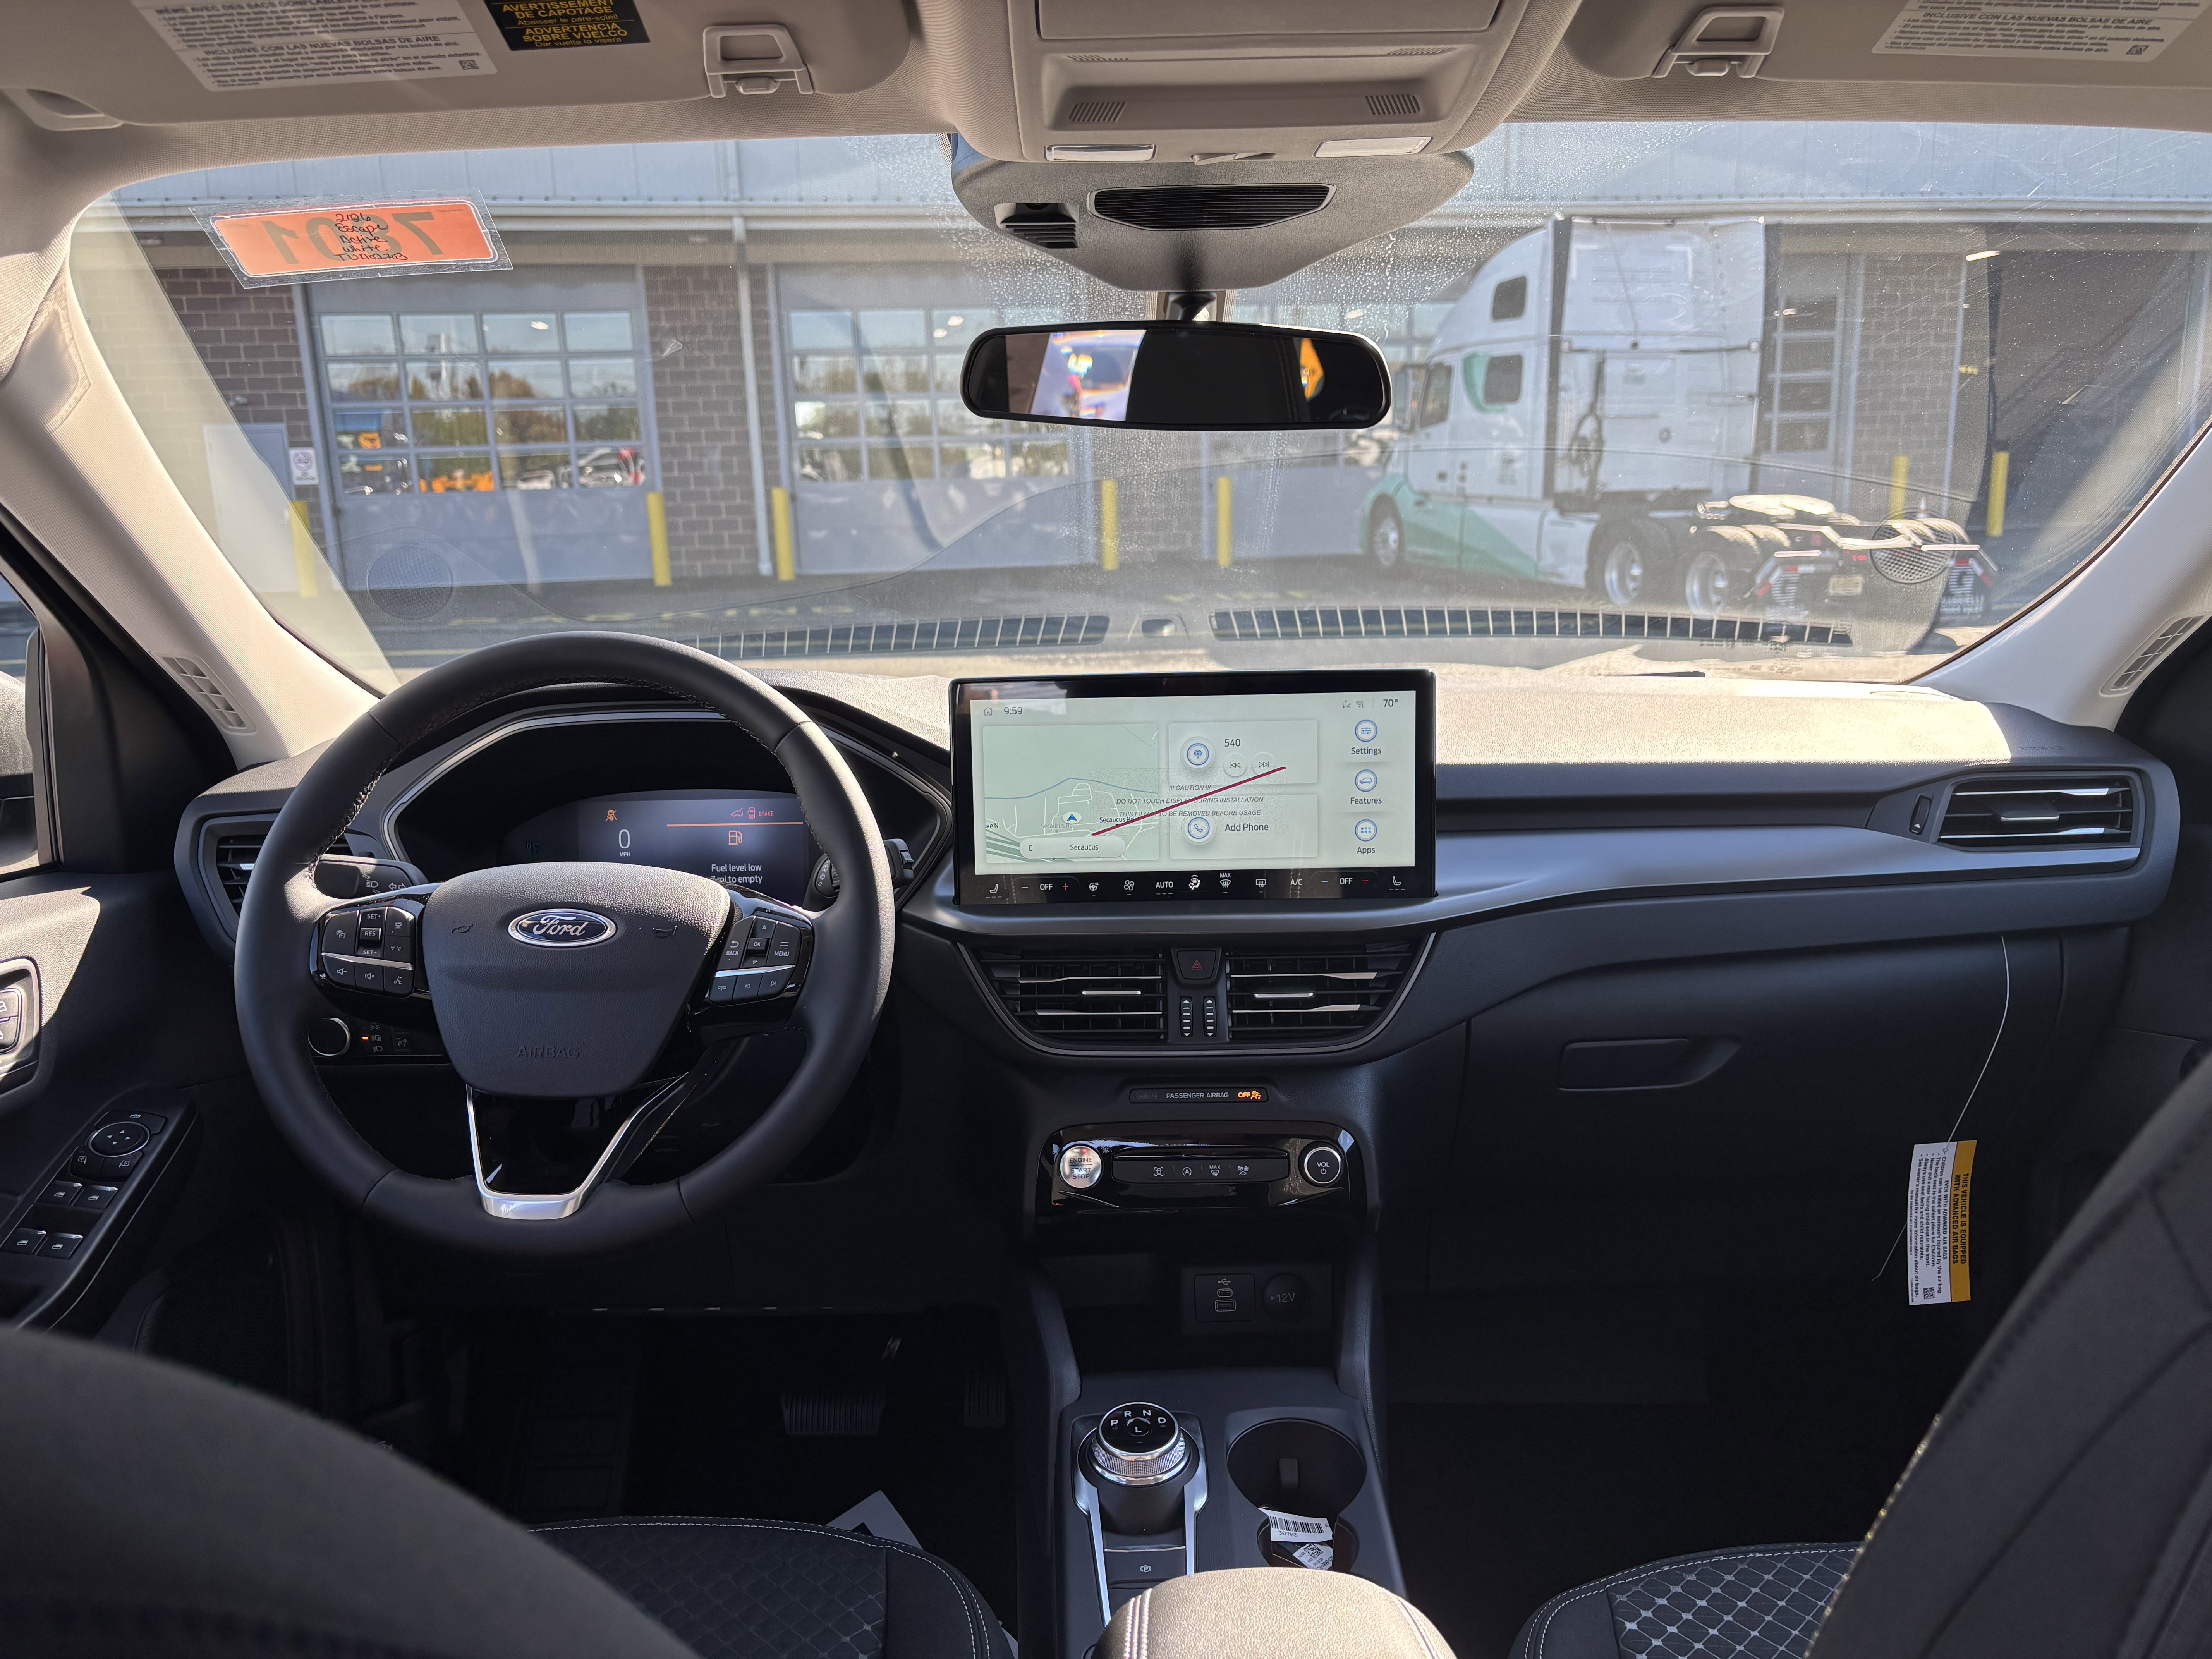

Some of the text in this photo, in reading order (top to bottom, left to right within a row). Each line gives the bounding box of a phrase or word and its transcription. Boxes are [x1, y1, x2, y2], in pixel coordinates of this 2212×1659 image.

[538, 6, 613, 17] CAPOTAGE
[571, 14, 619, 24] pare-soleil
[526, 23, 622, 35] ADVERTENCIA
[522, 29, 628, 43] SOBRE VUELCO
[204, 47, 259, 55] INCLUSIVE
[309, 41, 350, 49] NUEVAS
[353, 37, 396, 46] BOLSAS
[336, 213, 371, 222] 2026
[335, 223, 388, 237] Escape
[1383, 699, 1398, 708] 70°
[1004, 706, 1023, 715] 9:59
[1224, 738, 1241, 747] 540
[1351, 747, 1382, 755] Settings
[1224, 823, 1269, 832] Add Phone
[618, 829, 630, 849] 0
[1357, 847, 1376, 855] Apps
[711, 864, 727, 872] Fuel
[729, 863, 747, 872] level
[738, 875, 763, 884] empty
[1339, 877, 1353, 885] OFF
[533, 915, 589, 936] Ford
[517, 1046, 580, 1059] AIRBAG
[1276, 1292, 1295, 1303] 12V
